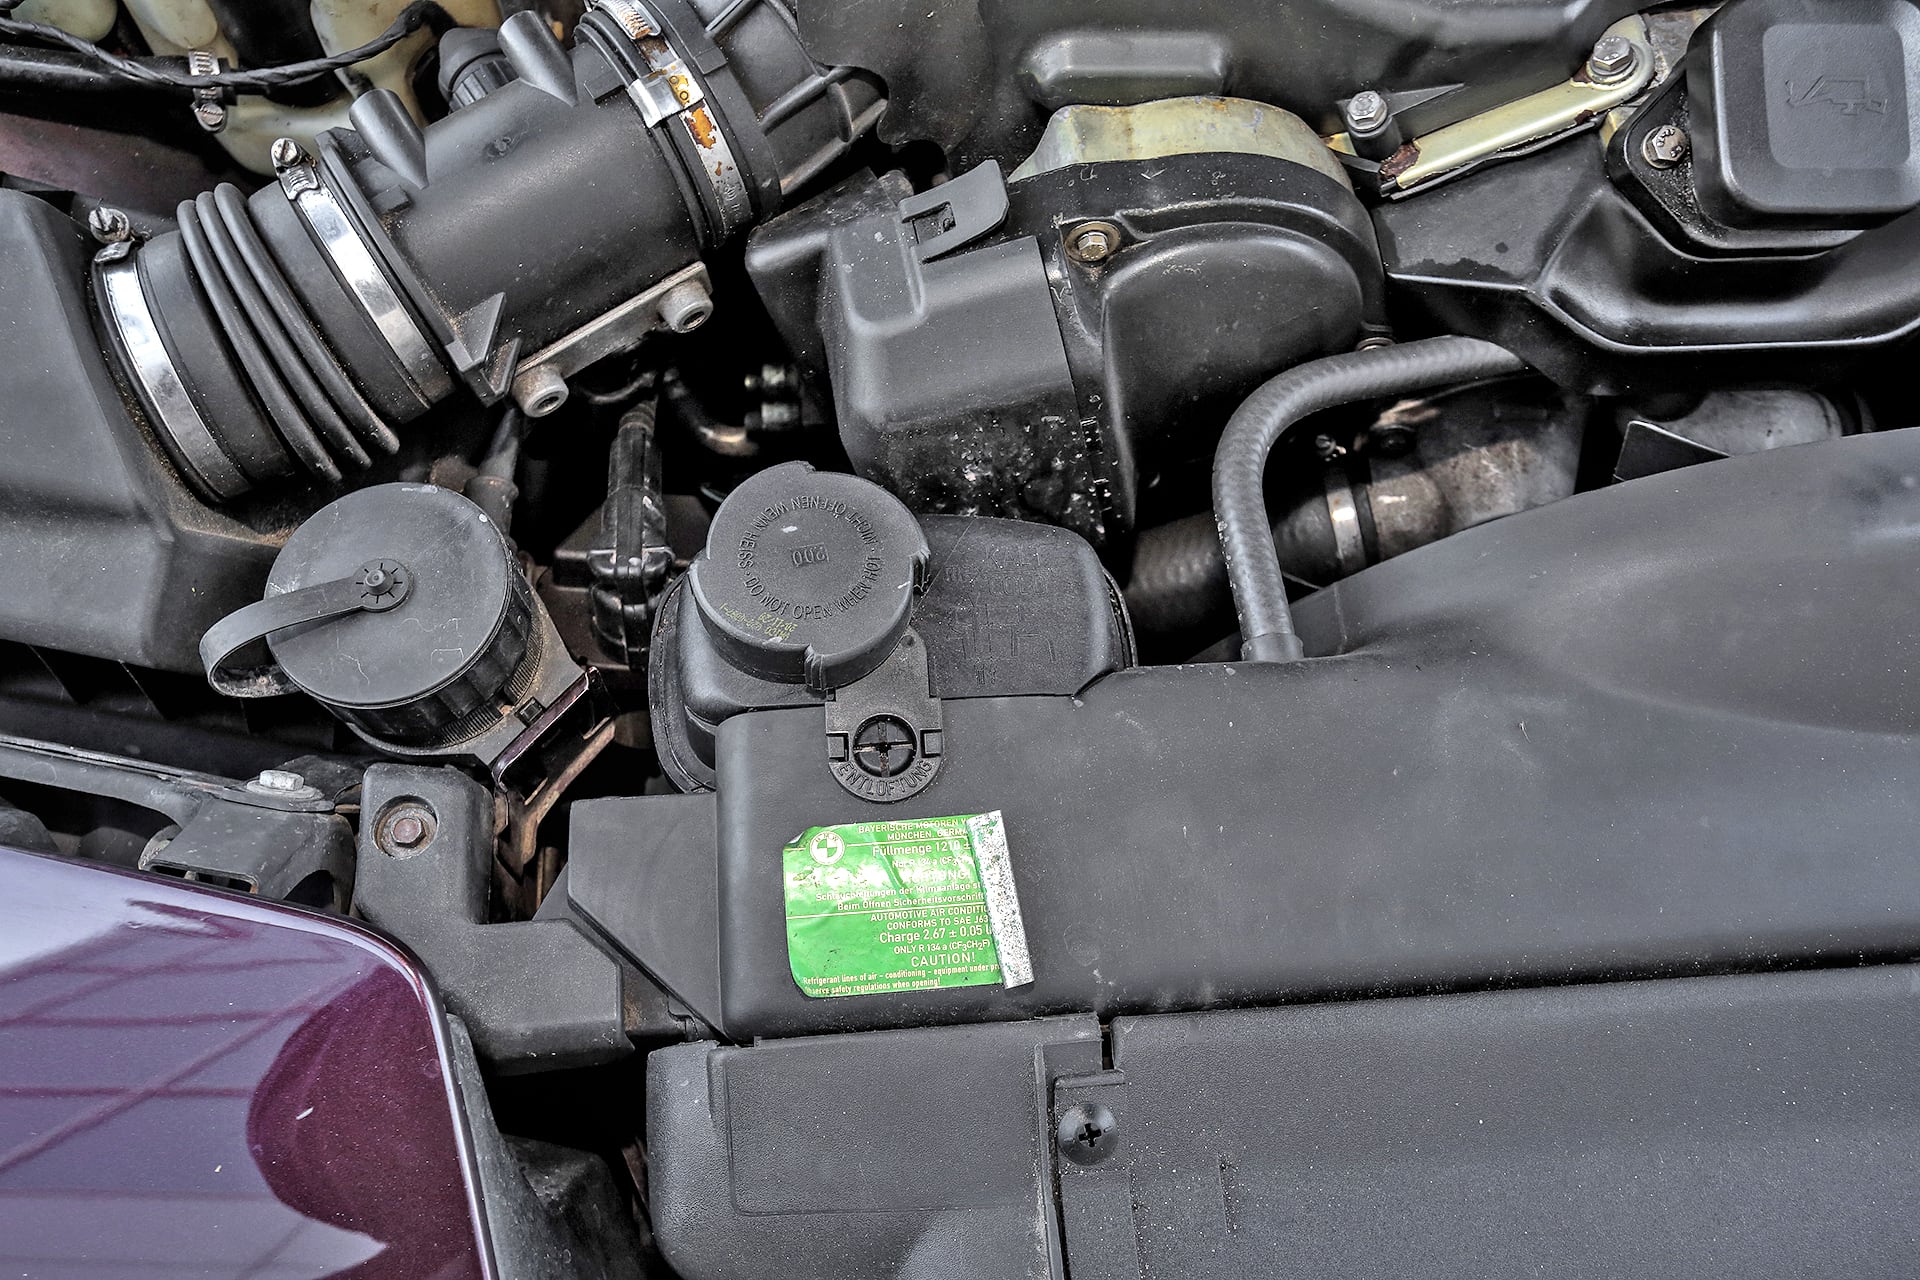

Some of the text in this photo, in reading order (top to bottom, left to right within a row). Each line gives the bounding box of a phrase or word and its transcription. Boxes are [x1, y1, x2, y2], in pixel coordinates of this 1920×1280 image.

[738, 495, 879, 569] NICHT ÖFFNEN WENN HEISS
[743, 555, 884, 620] DO NOT OPEN WHEN HOT
[858, 822, 915, 834] BAYERISCHE
[915, 818, 959, 829] MOTOREN
[872, 843, 932, 857] Füllmenge
[900, 886, 914, 896] der
[837, 902, 860, 911] Beim
[871, 909, 928, 922] AUTOMOTIVE
[929, 908, 946, 917] AIR
[887, 919, 938, 931] CONFORMS
[939, 918, 951, 927] TO
[953, 916, 972, 926] SAE
[879, 931, 921, 944] Charge
[922, 927, 946, 940] 2.67
[959, 925, 983, 938] 0.05
[893, 944, 917, 955] ONLY
[918, 944, 925, 952] R
[926, 943, 941, 952] 134
[910, 951, 976, 968] CAUTION!
[803, 974, 841, 986] Refrigerant
[841, 973, 858, 983] lines
[859, 972, 867, 981] of
[867, 971, 878, 980] air
[885, 968, 926, 979] conditioning
[933, 964, 969, 976] equipment
[969, 963, 989, 973] under
[853, 981, 891, 992] regulations
[892, 979, 911, 989] when
[911, 976, 941, 989] opening!
